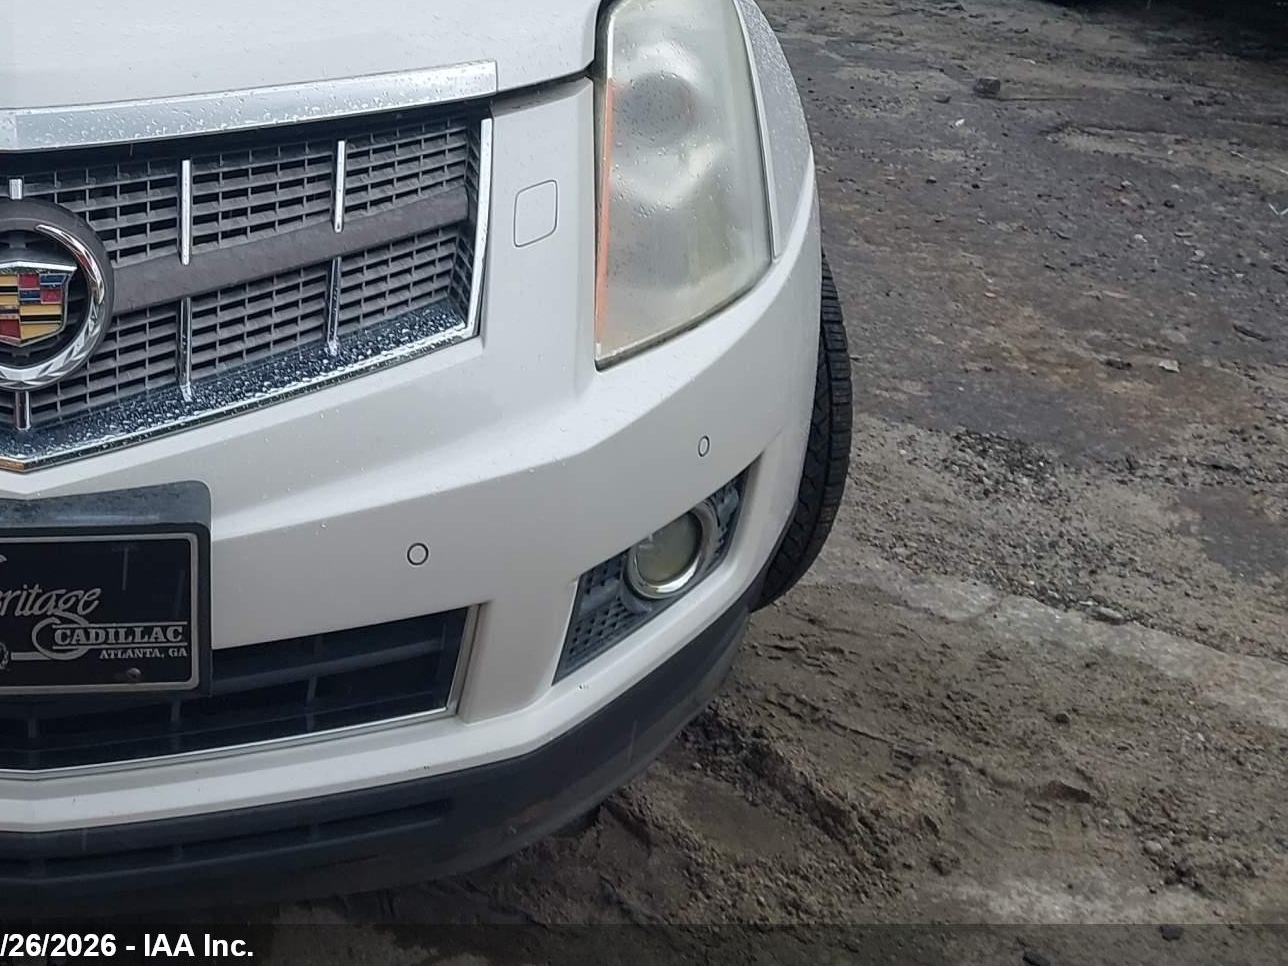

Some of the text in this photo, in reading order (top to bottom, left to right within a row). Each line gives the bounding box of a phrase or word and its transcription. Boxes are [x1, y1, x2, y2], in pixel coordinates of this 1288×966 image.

[54, 626, 183, 645] CADILLAC
[100, 648, 187, 659] ATLANTA, GA
